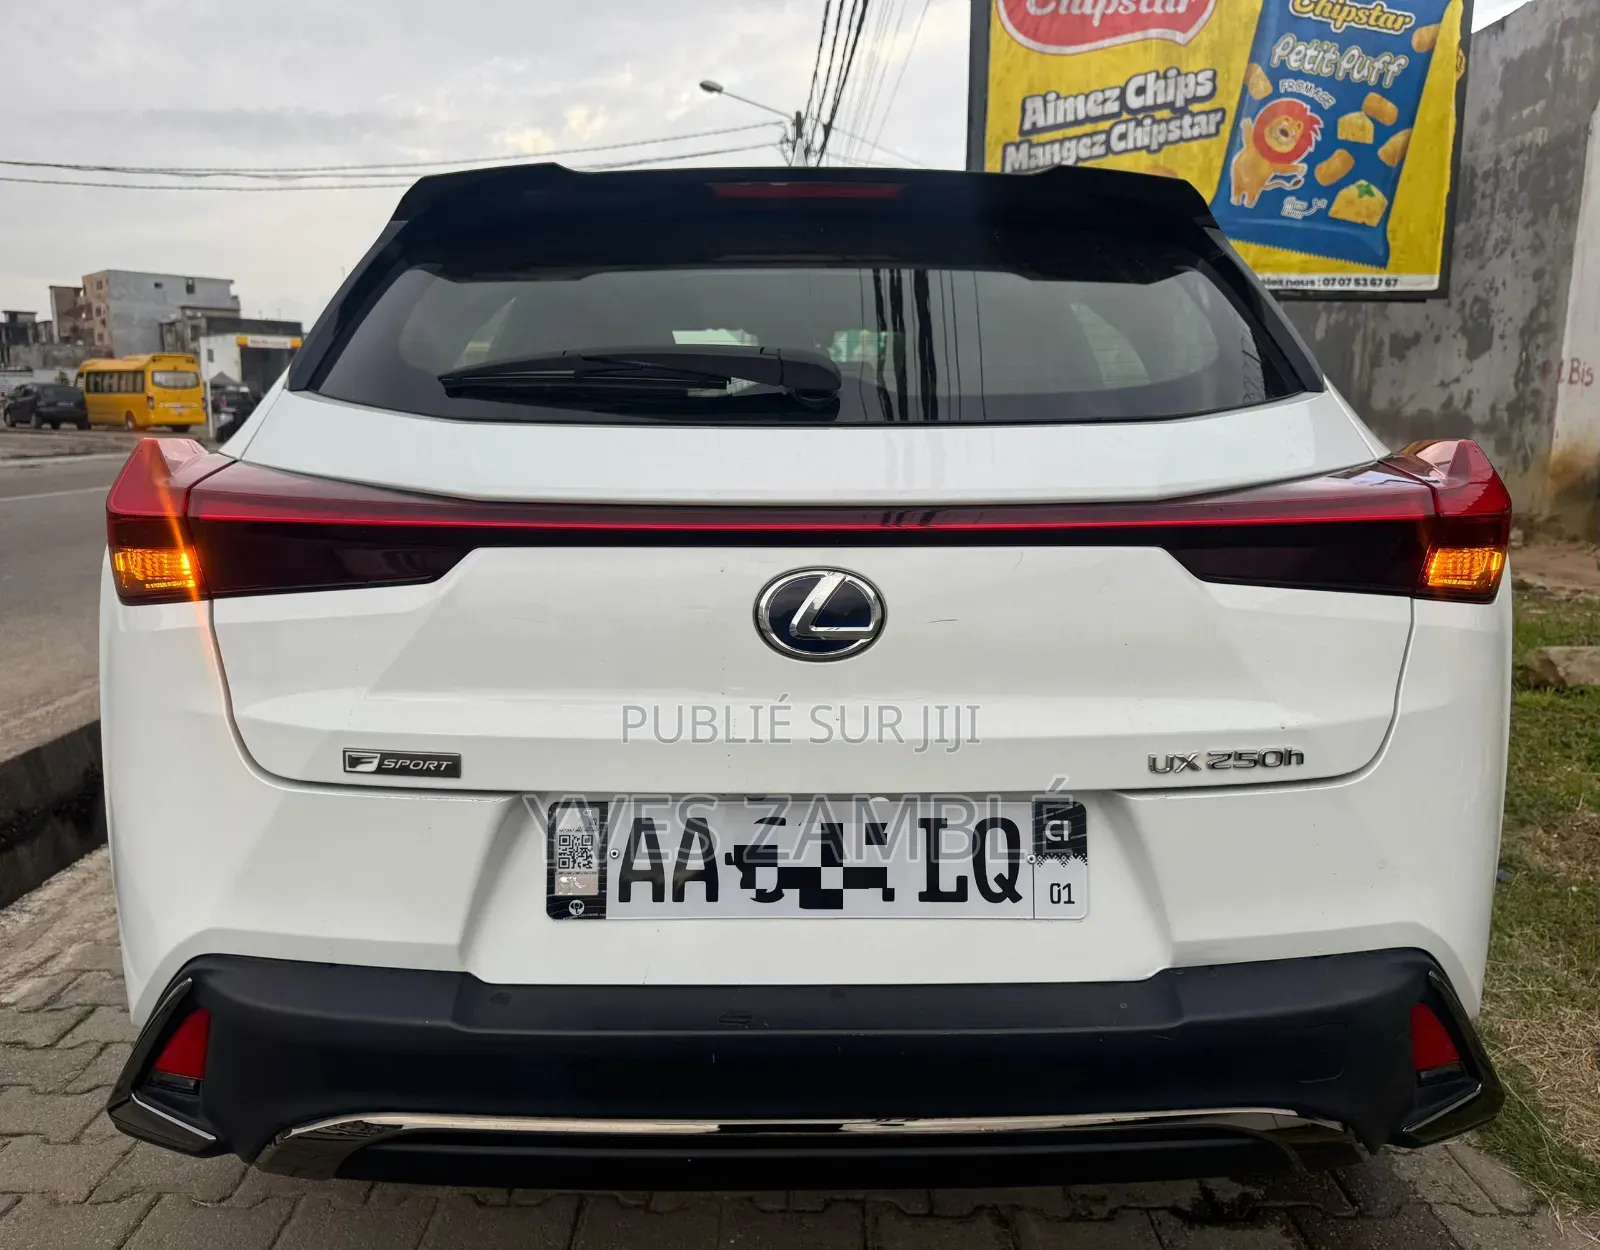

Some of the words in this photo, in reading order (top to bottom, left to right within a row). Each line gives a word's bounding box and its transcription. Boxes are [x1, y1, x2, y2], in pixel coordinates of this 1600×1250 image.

[1271, 34, 1339, 76] Petit
[1335, 45, 1409, 88] Puff
[1021, 87, 1121, 132] Aimez
[1124, 67, 1216, 108] Chips
[1279, 78, 1336, 110] FROMAGE
[1003, 133, 1107, 173] Mangez
[1109, 111, 1223, 150] Chipstar
[1322, 277, 1336, 287] 07
[1338, 277, 1352, 287] 07
[381, 758, 453, 771] SPORT
[1148, 752, 1202, 774] UX
[1206, 746, 1304, 770] 250h
[618, 816, 719, 903] AA
[917, 816, 1024, 904] LQ
[1049, 882, 1076, 905] 01
